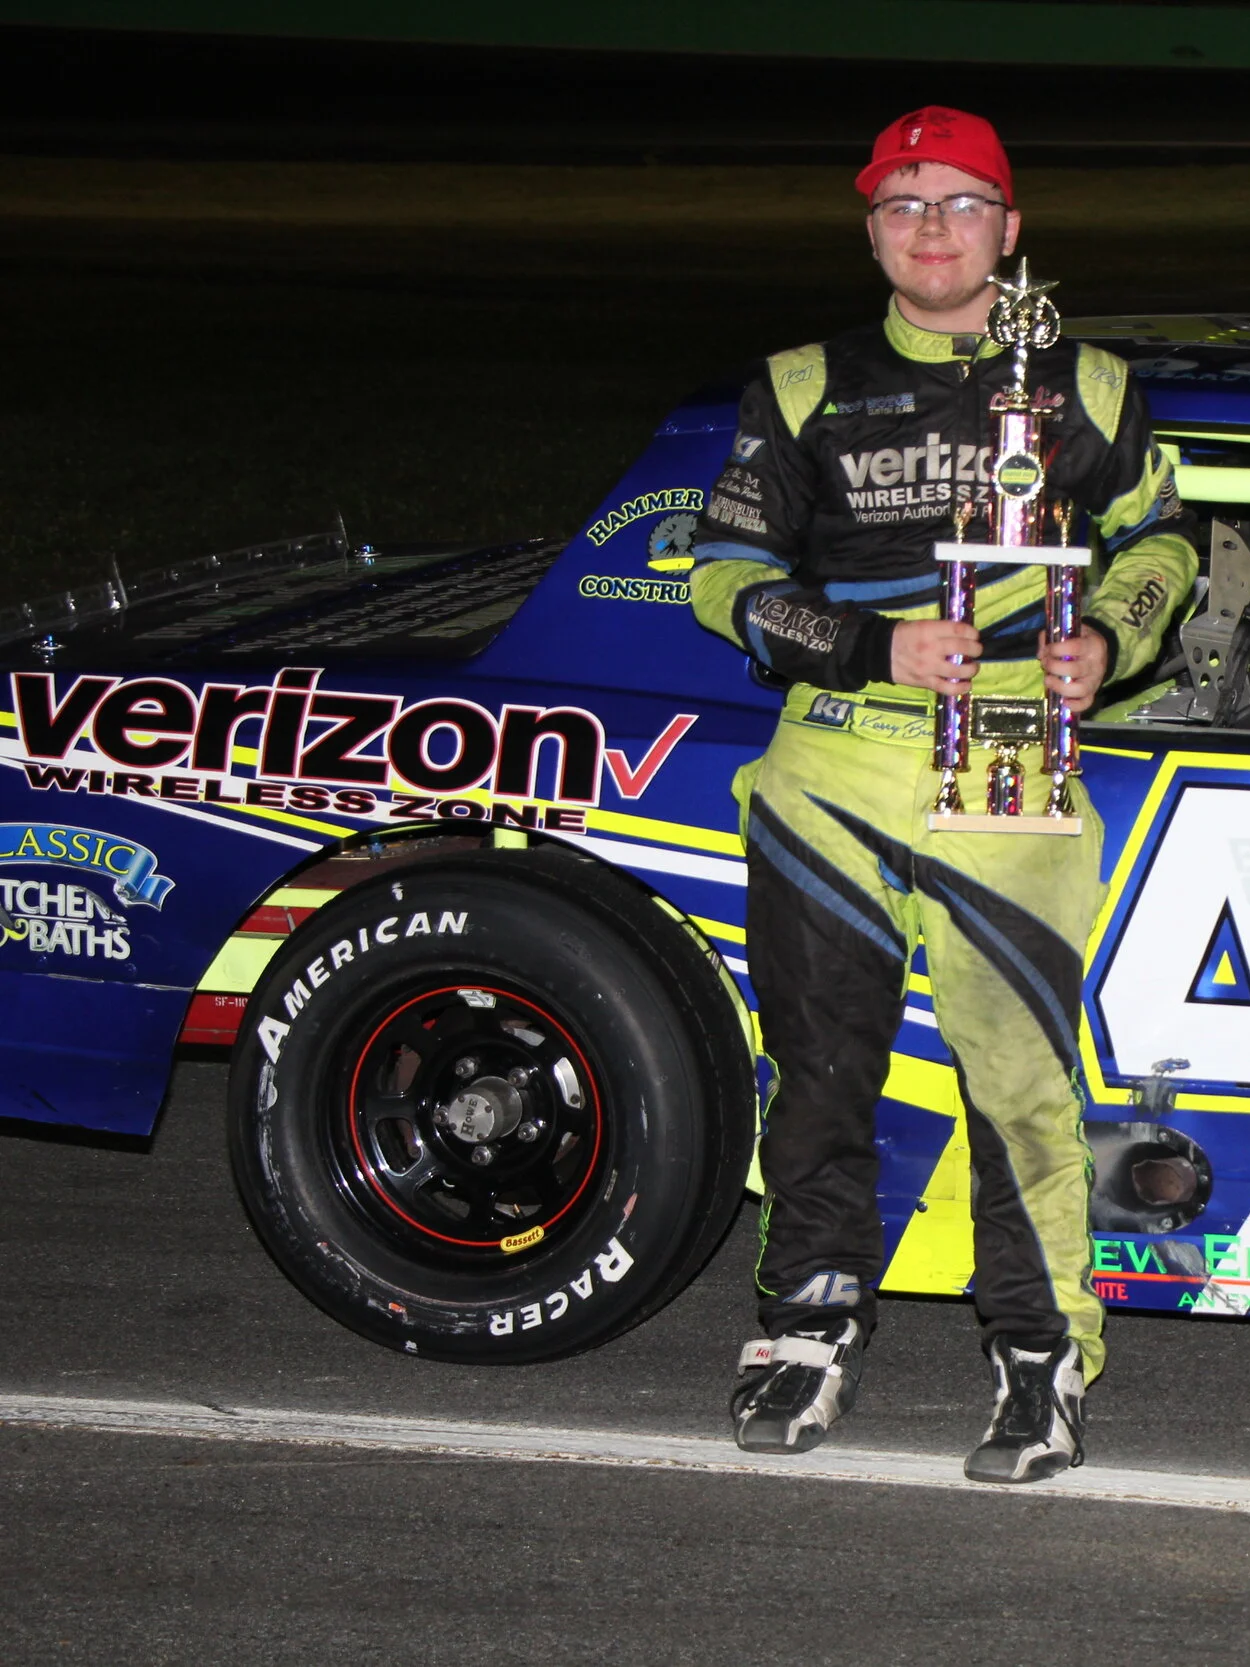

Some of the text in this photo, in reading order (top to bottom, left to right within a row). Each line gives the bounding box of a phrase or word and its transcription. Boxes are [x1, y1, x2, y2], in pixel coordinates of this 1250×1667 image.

[587, 488, 704, 546] HAMMER
[854, 510, 900, 524] Verizon
[579, 575, 691, 605] CONSTRU
[813, 693, 850, 721] K1
[10, 667, 605, 806] verizon
[22, 762, 588, 836] WIRELESS ZONE
[0, 828, 136, 875] ASSIC
[29, 919, 131, 960] BATHS
[257, 911, 469, 1063] AMERICAN
[506, 1229, 541, 1248] Bassett
[489, 1236, 636, 1337] RACER
[1178, 1291, 1216, 1309] AN
